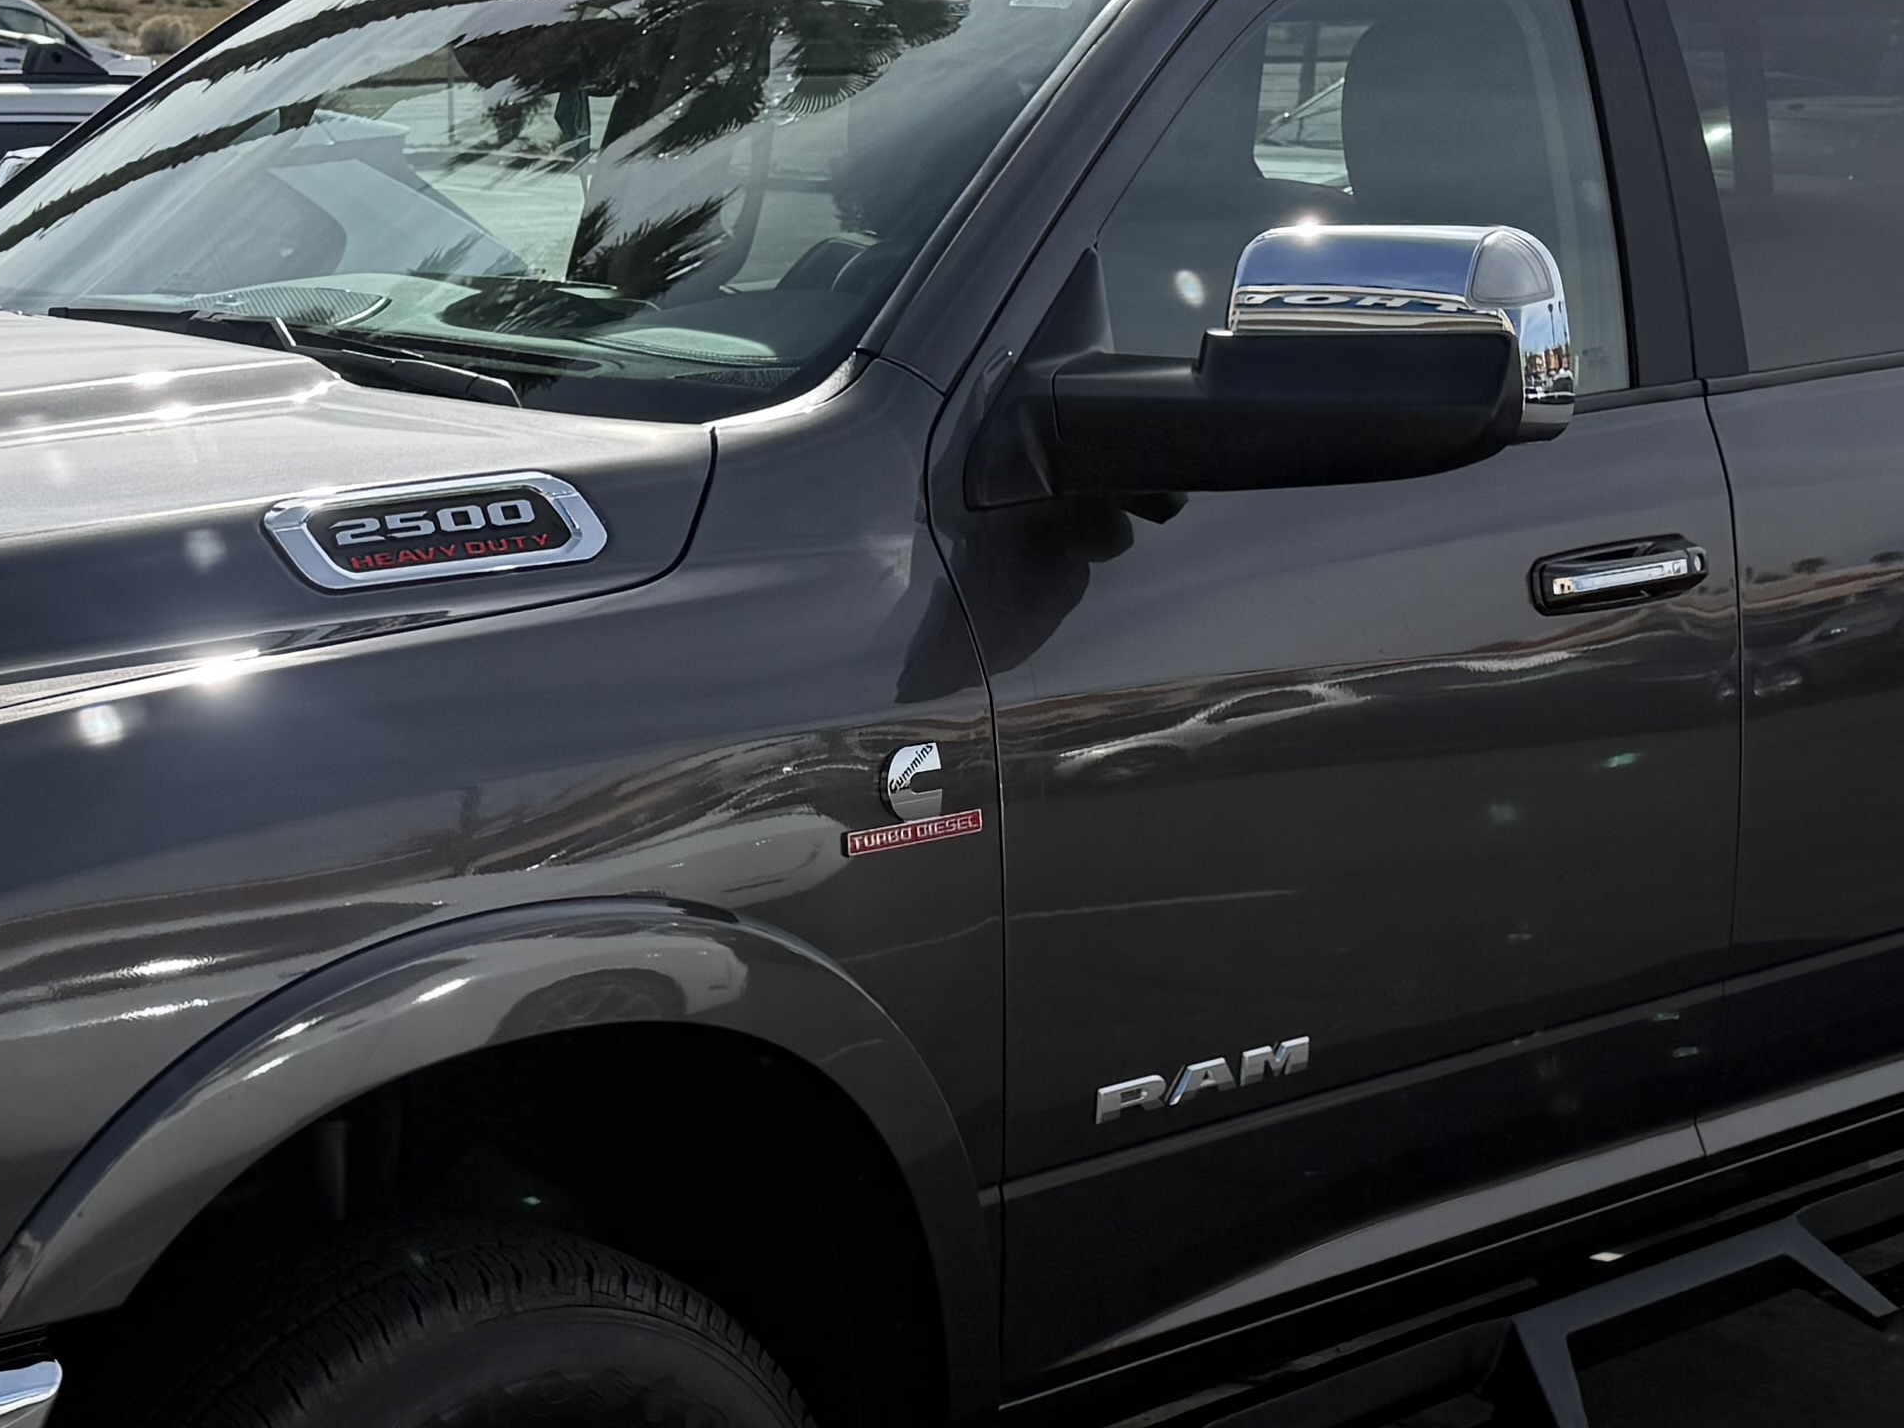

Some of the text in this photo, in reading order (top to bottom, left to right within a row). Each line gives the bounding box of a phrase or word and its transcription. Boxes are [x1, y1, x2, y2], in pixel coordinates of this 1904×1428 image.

[329, 498, 536, 546] 2500
[350, 532, 550, 570] HEAVY DUTY
[889, 743, 934, 794] Cummins
[852, 815, 979, 851] TURBO DIESEL
[1095, 1035, 1310, 1125] RAM
